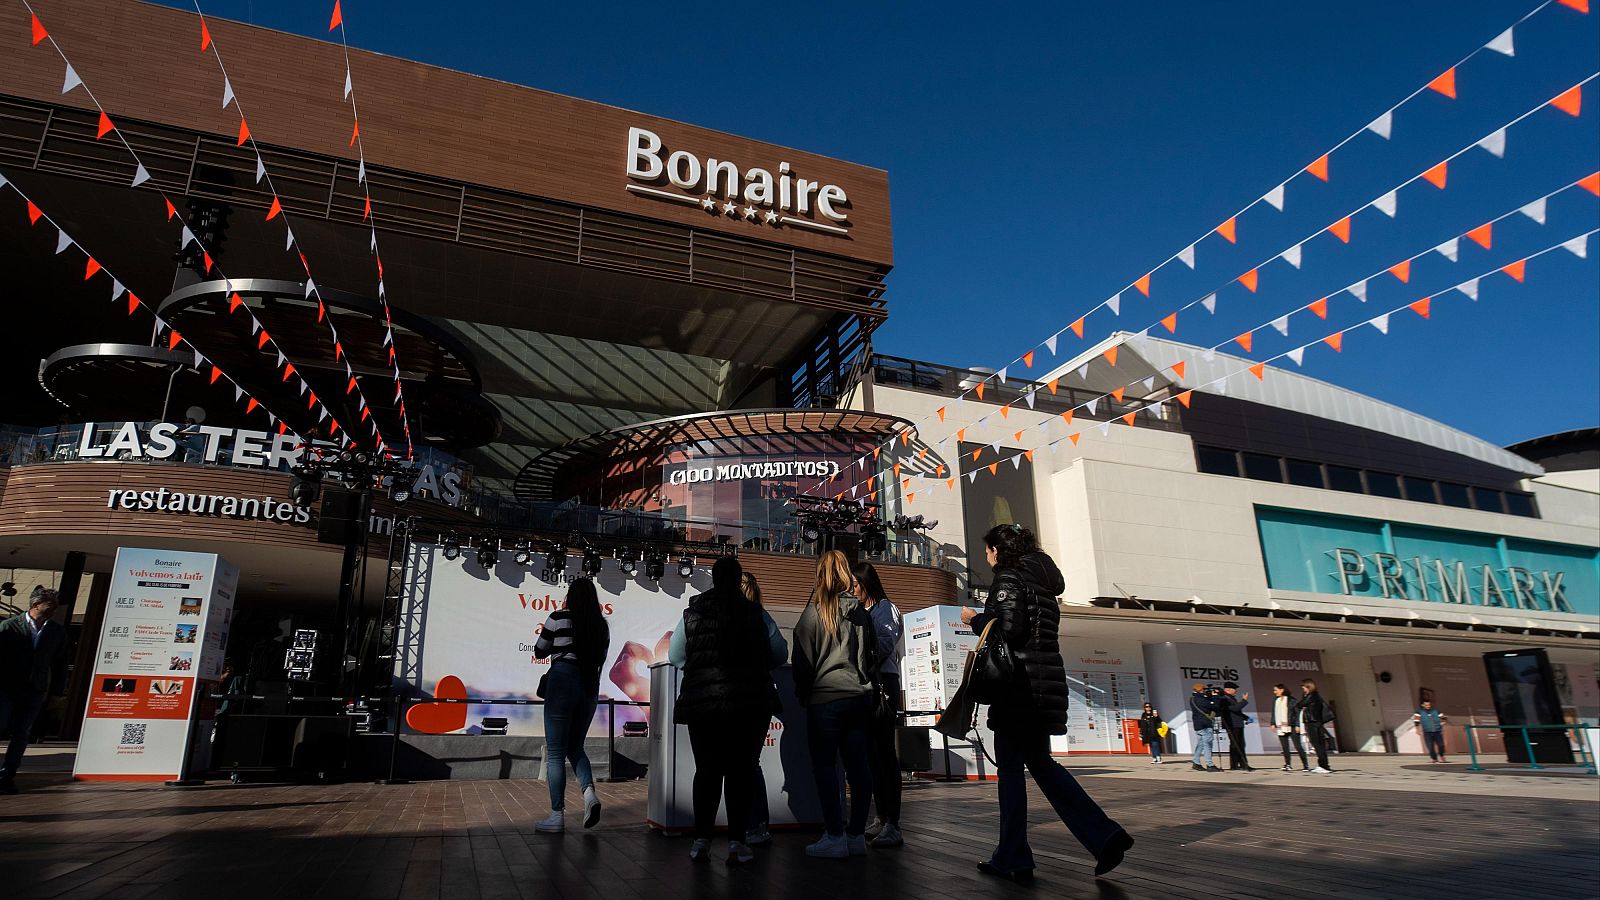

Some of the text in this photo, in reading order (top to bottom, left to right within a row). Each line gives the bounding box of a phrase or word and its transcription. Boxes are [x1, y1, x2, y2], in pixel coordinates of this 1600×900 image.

[626, 126, 848, 221] Bonaire
[79, 421, 462, 506] LAS TERAS
[107, 487, 311, 524] restaurantes
[129, 569, 174, 580] Volvemos
[183, 571, 204, 581] latir
[154, 558, 183, 567] Bonaire
[1336, 548, 1576, 614] PRIMARK
[518, 593, 613, 616] Volvs
[1252, 658, 1320, 672] CALZEDONIA
